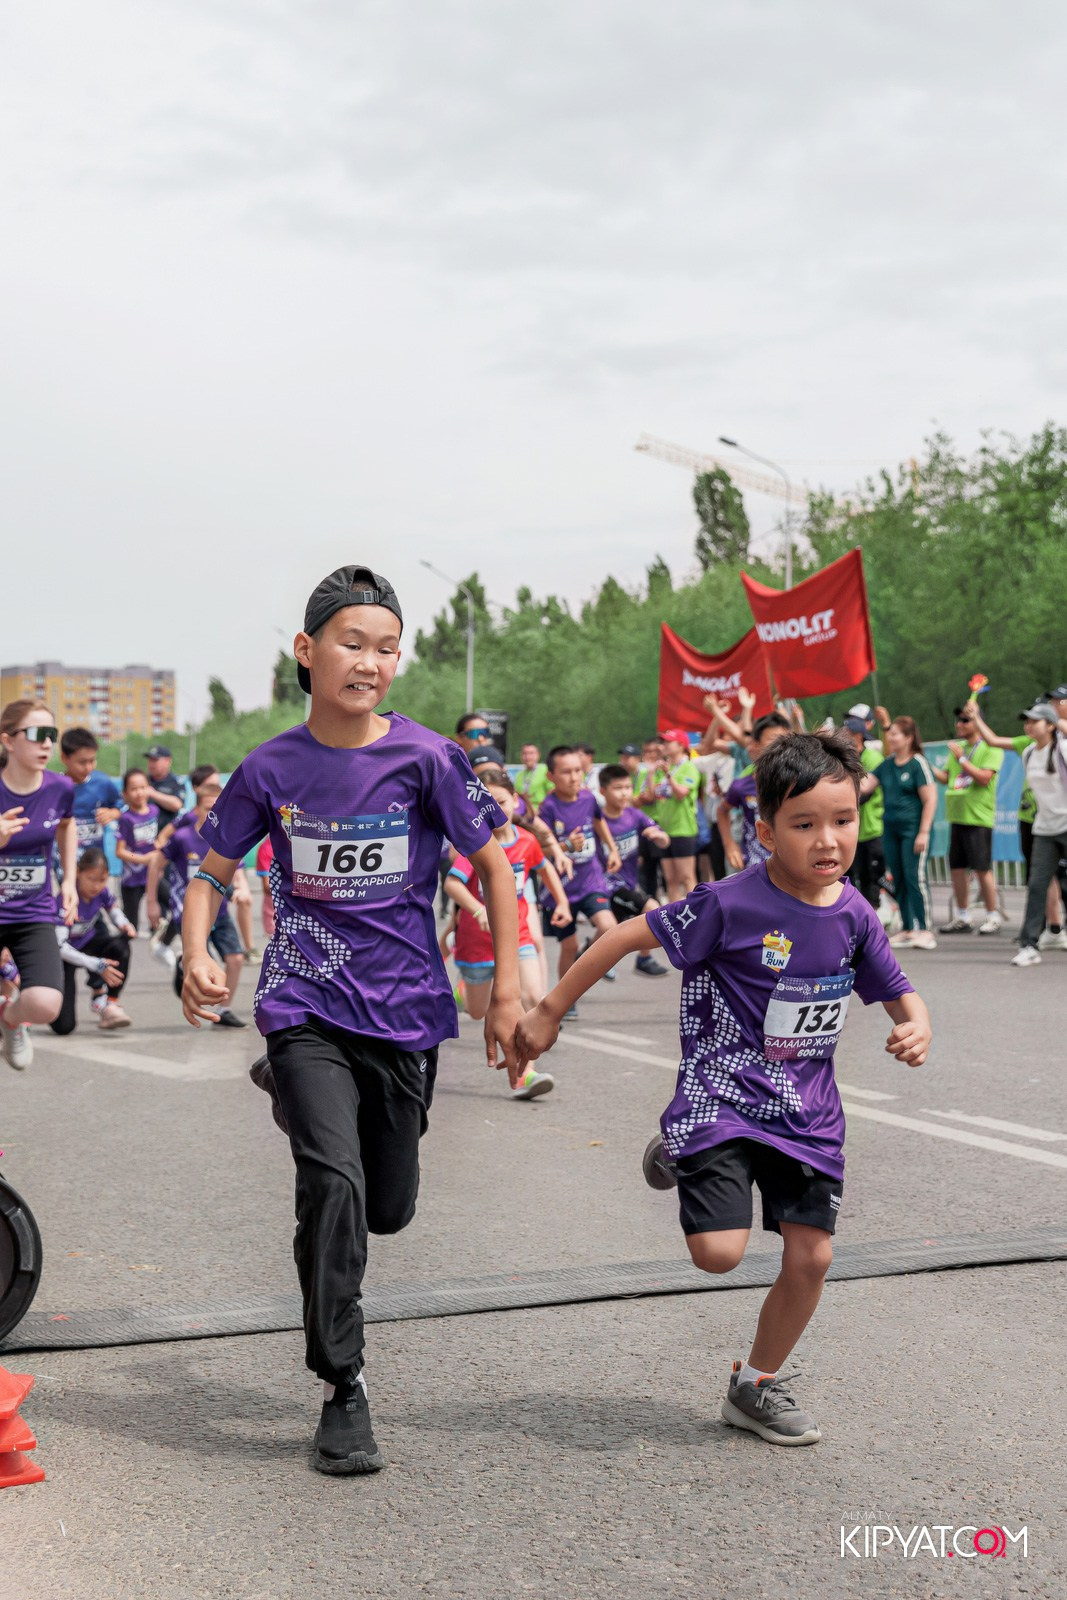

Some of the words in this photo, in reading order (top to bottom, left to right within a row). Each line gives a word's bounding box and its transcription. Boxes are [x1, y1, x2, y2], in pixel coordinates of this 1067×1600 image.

[317, 842, 385, 874] 166
[296, 874, 348, 888] БАЛАЛАР
[349, 873, 403, 887] ЖАРЫСЫ
[331, 889, 355, 898] 600
[659, 909, 675, 934] Arena
[671, 931, 683, 949] City
[765, 951, 775, 959] BI
[766, 958, 785, 967] RUN
[792, 1002, 841, 1034] 132
[764, 1037, 813, 1049] БАЛАЛАР
[797, 1048, 816, 1057] 600
